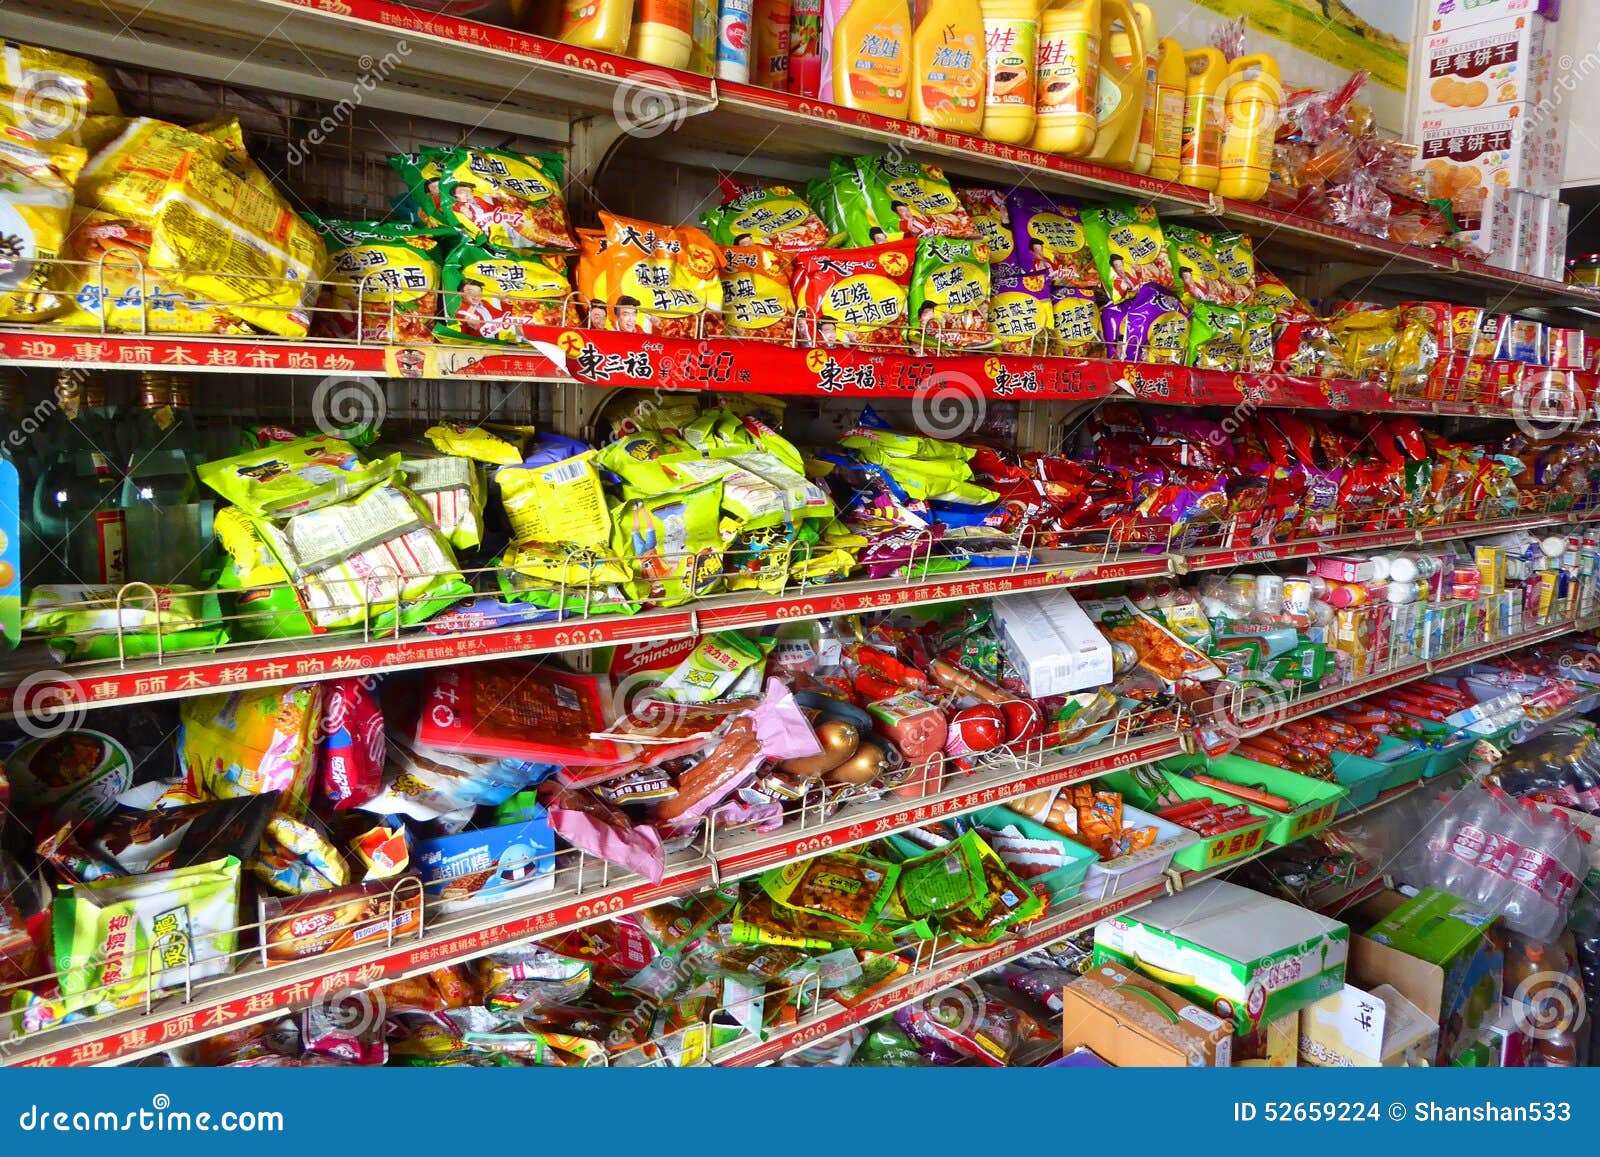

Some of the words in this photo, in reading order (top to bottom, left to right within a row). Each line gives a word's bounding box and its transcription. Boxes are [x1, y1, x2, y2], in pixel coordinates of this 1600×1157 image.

[507, 35, 543, 53] 丁先生
[860, 33, 901, 60] 洛娃
[1038, 40, 1066, 66] 娃
[1433, 41, 1478, 57] BREAKFAST
[1479, 32, 1518, 48] BISCUITS
[932, 47, 973, 69] 洛娃
[1434, 43, 1514, 74] 早餐饼干
[1426, 126, 1471, 139] BREAKFAST
[1474, 121, 1511, 134] BISCUITS
[1427, 132, 1507, 156] 早餐饼干
[652, 288, 701, 312] 牛肉面
[830, 282, 871, 310] 红烧
[735, 299, 785, 323] 牛肉面
[843, 297, 899, 328] 牛肉面
[997, 317, 1038, 335] 牛肉面
[1060, 320, 1094, 340] 牛肉面
[561, 335, 580, 353] 大
[501, 359, 536, 370] 丁先生
[809, 352, 826, 368] 大
[986, 359, 999, 374] 大
[858, 580, 1013, 607] 欢迎惠顾本超市购物
[632, 634, 696, 669] Shineway
[875, 780, 1026, 831] 欢迎惠顾本超市购物
[524, 912, 556, 927] 丁先生
